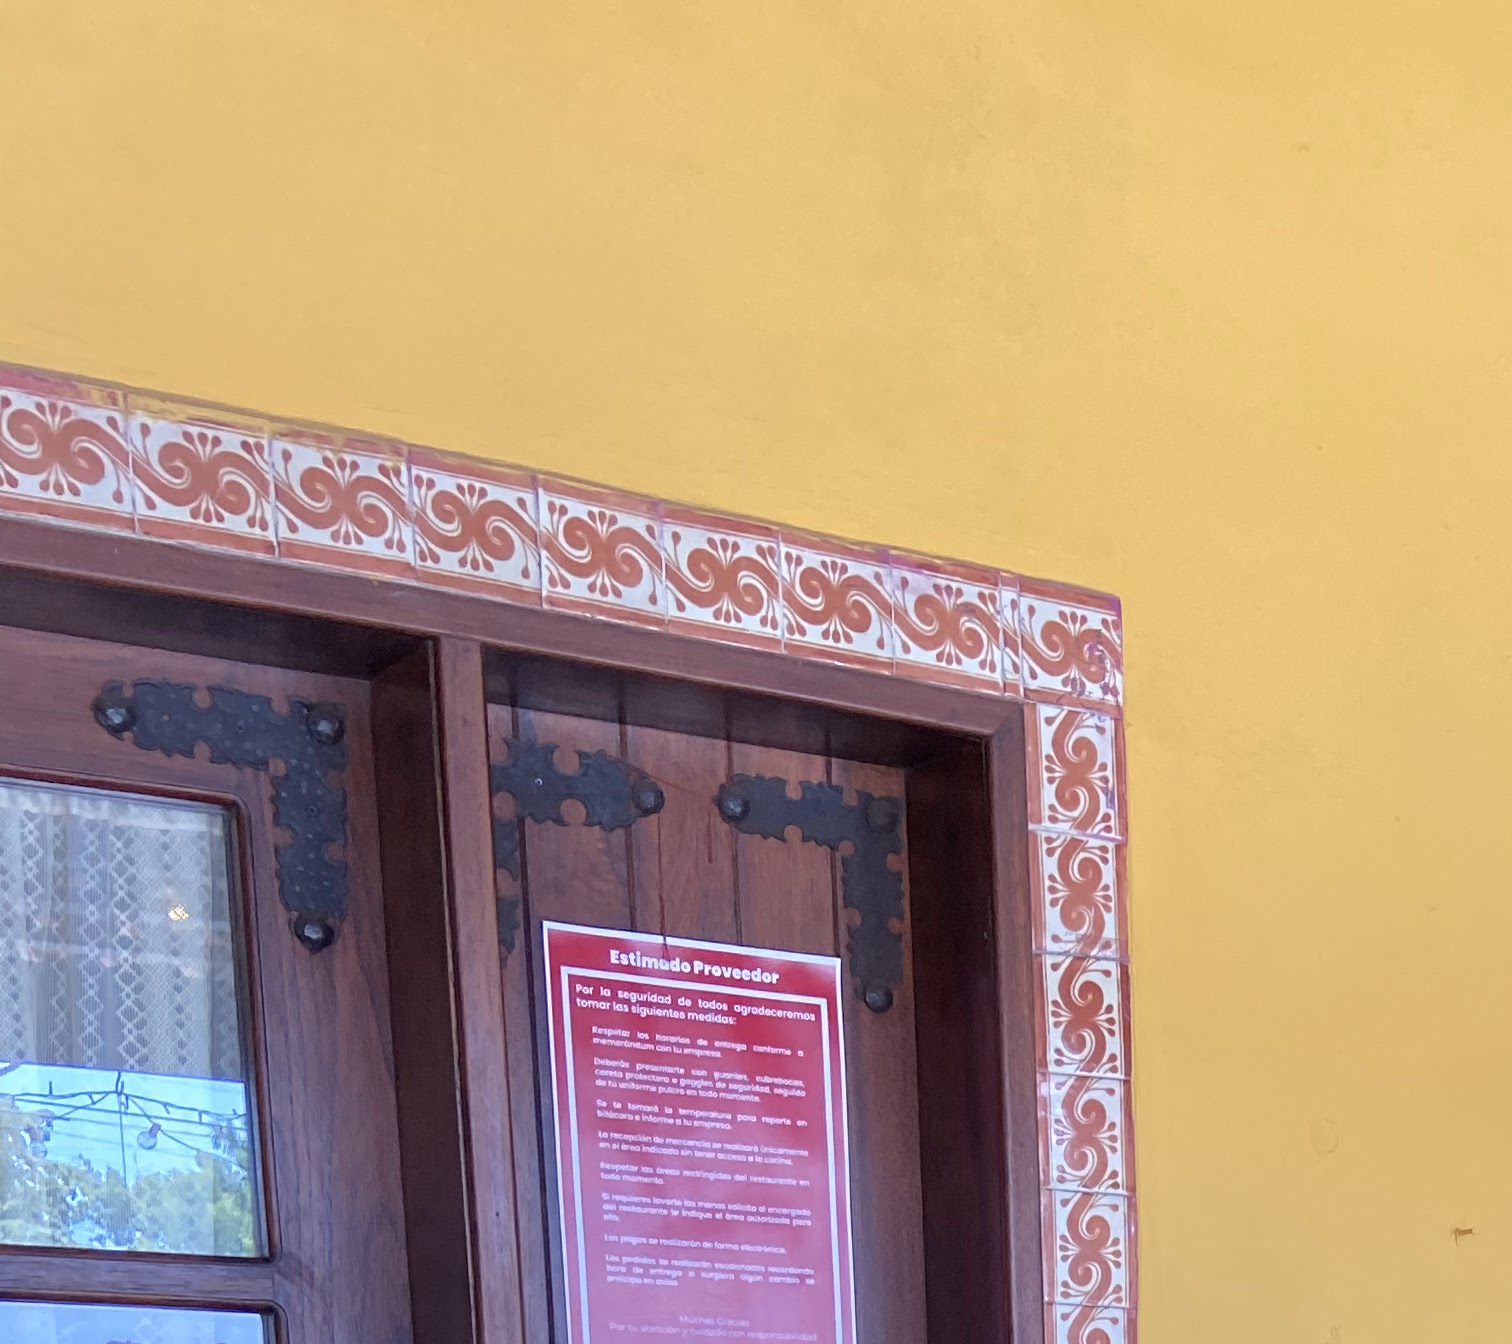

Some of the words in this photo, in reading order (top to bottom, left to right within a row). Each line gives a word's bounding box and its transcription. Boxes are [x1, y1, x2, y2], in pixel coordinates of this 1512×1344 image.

[609, 949, 692, 975] Estimado
[693, 960, 779, 985] Proveedor
[575, 983, 594, 995] Por
[599, 986, 611, 997] la
[617, 988, 671, 1006] seguridad
[677, 995, 692, 1007] de
[698, 997, 727, 1011] todos
[733, 1002, 815, 1023] agradeceremos
[576, 996, 610, 1010] tomar
[612, 1001, 629, 1012] las
[630, 1003, 685, 1021] siguientes
[687, 1009, 736, 1025] medidas:
[591, 1025, 630, 1038] Respetar
[636, 1030, 649, 1039] los
[655, 1033, 690, 1044] horarios
[696, 1037, 708, 1046] de
[655, 1044, 671, 1052] con
[698, 1089, 718, 1098] todo
